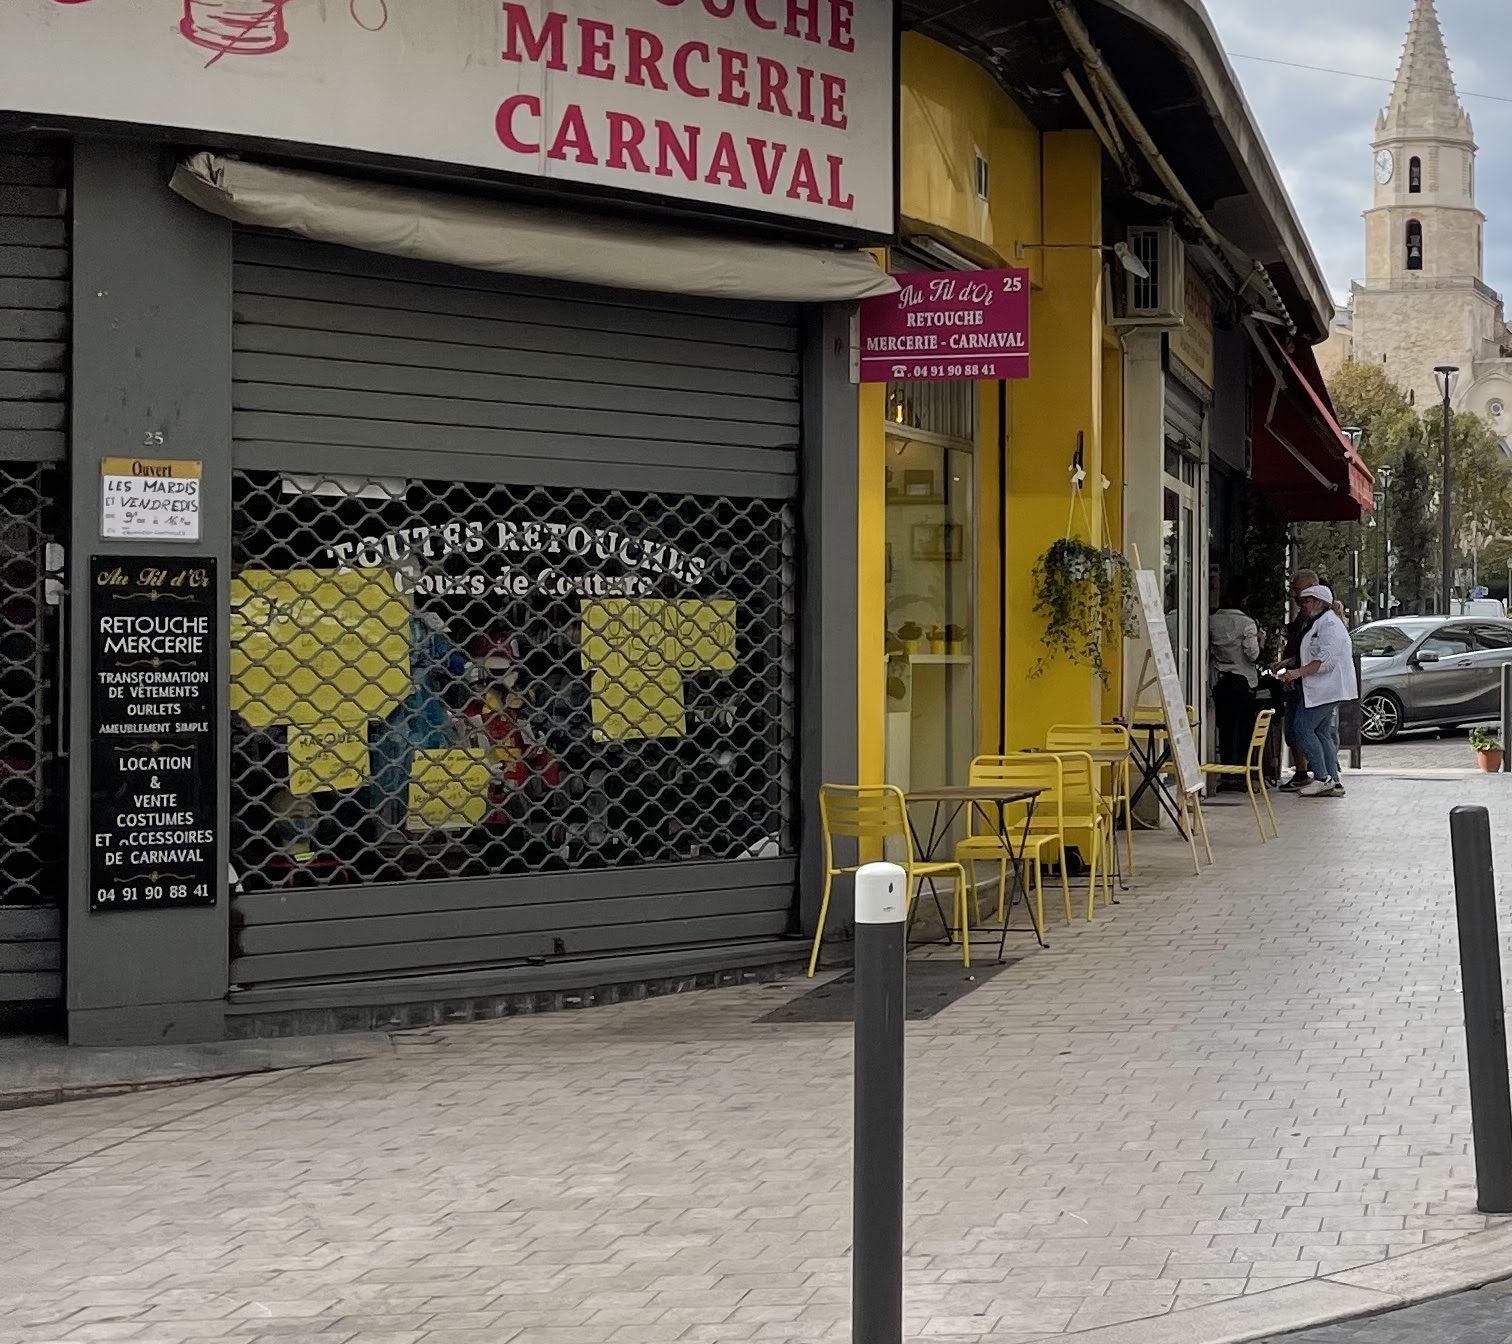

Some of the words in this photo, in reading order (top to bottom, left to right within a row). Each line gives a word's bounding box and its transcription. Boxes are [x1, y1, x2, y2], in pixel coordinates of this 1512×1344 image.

[501, 2, 848, 131] MERCERIE
[495, 95, 854, 211] CARNAVAL
[1003, 277, 1022, 292] 25
[898, 284, 924, 310] Au
[929, 278, 956, 302] Fil
[958, 281, 993, 306] d'Or
[906, 310, 984, 328] RETOUCHE
[866, 335, 938, 351] MERCERIE
[949, 333, 1025, 349] CARNAVAL
[913, 365, 928, 377] 04
[930, 365, 944, 377] 91
[947, 364, 962, 376] 90
[964, 364, 979, 376] 88
[981, 363, 995, 376] 41
[143, 431, 164, 445] 25
[131, 460, 173, 477] Ouvert
[108, 480, 133, 492] LES
[143, 480, 197, 496] MARDIS
[120, 496, 198, 513] VENDREDIS
[97, 567, 129, 586] Au
[136, 567, 168, 587] Fil
[170, 568, 210, 588] d'Or
[493, 565, 529, 596] de
[100, 616, 209, 634] RETOUCHE
[103, 636, 203, 654] MERCERIE
[98, 671, 209, 684] TRANSFORMATION
[108, 686, 124, 699] DE
[130, 682, 199, 699] VÊTEMENTS
[127, 703, 182, 716] OURLETS
[98, 722, 171, 734] AMEUBLEMENT
[175, 721, 209, 733] SIMPLE
[119, 756, 192, 771] LOCATION
[150, 775, 161, 789] &
[133, 794, 178, 808] VENTE
[116, 812, 194, 827] COSTUMES
[95, 833, 112, 847] ET
[105, 851, 124, 865] DE
[130, 849, 204, 865] CARNAVAL
[97, 888, 116, 902] 04
[122, 887, 138, 901] 91
[145, 886, 163, 900] 90
[169, 885, 187, 899] 88
[193, 884, 209, 897] 41
